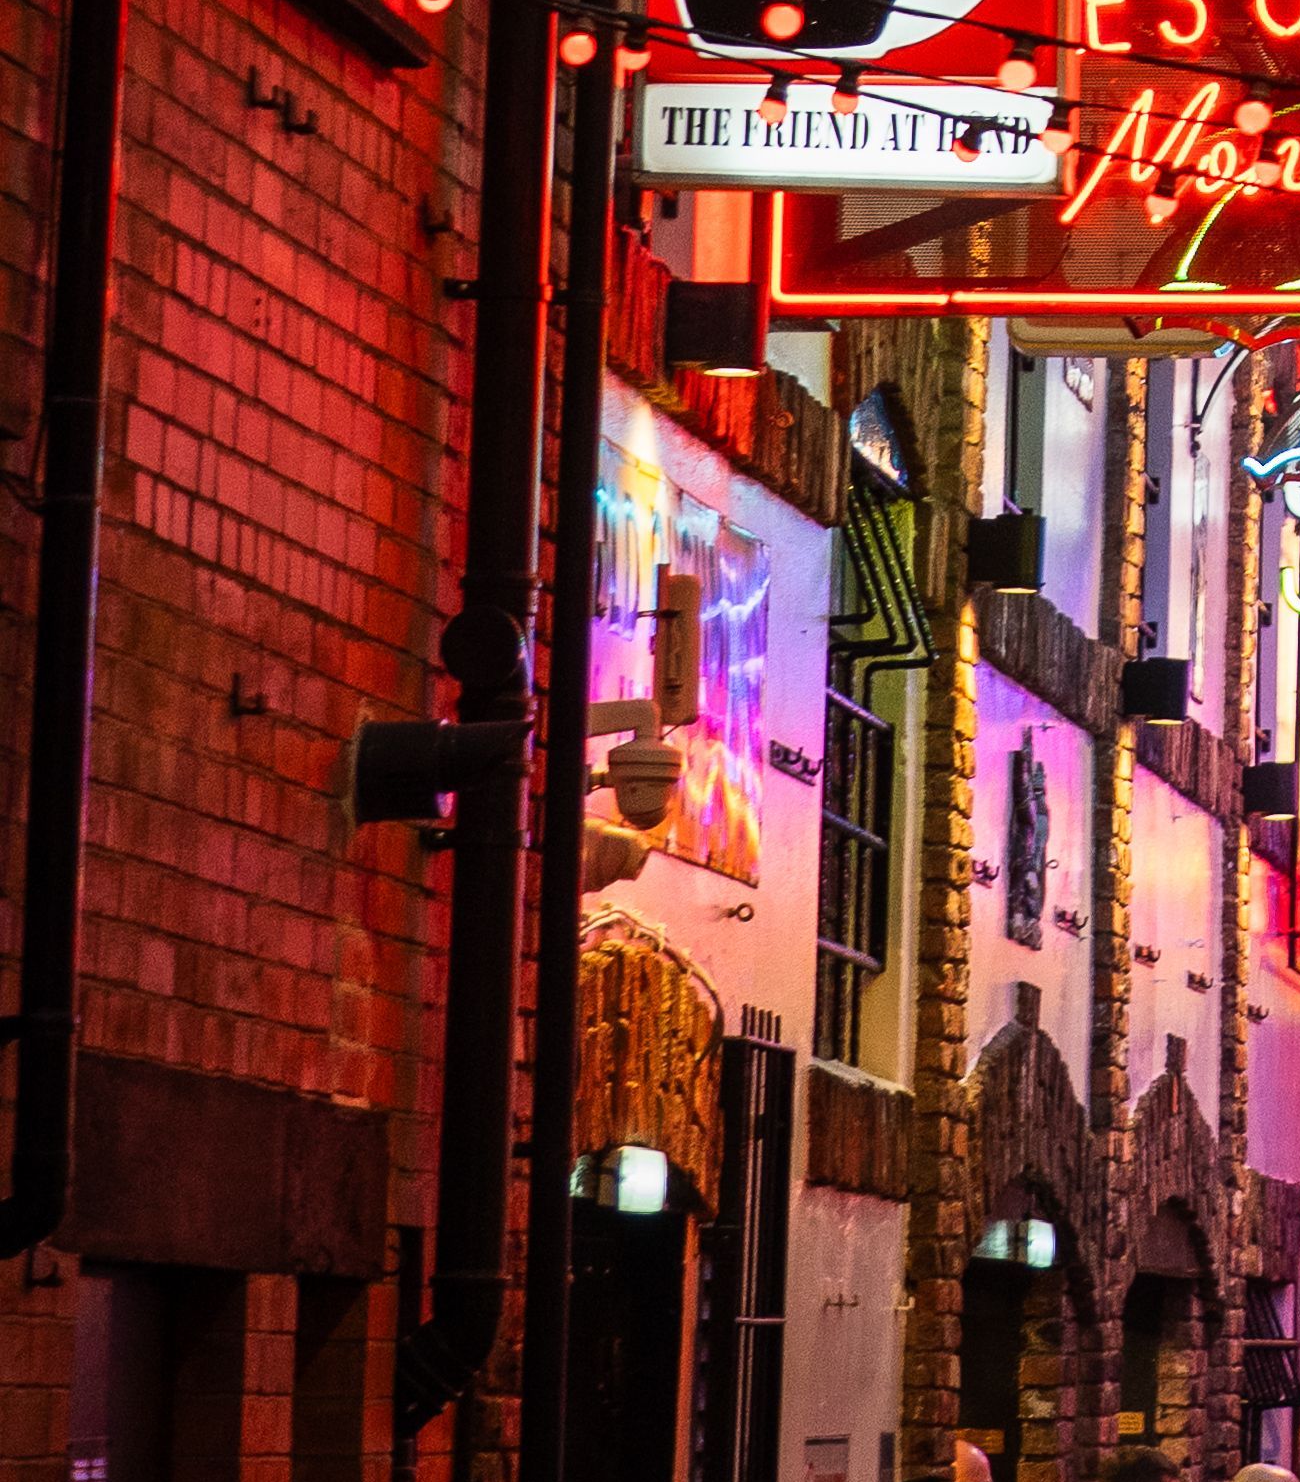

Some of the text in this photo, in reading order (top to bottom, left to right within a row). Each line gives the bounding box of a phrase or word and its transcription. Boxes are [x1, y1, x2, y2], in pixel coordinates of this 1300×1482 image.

[661, 109, 731, 145] THE
[741, 110, 866, 150] FRIEND
[880, 114, 924, 150] AT
